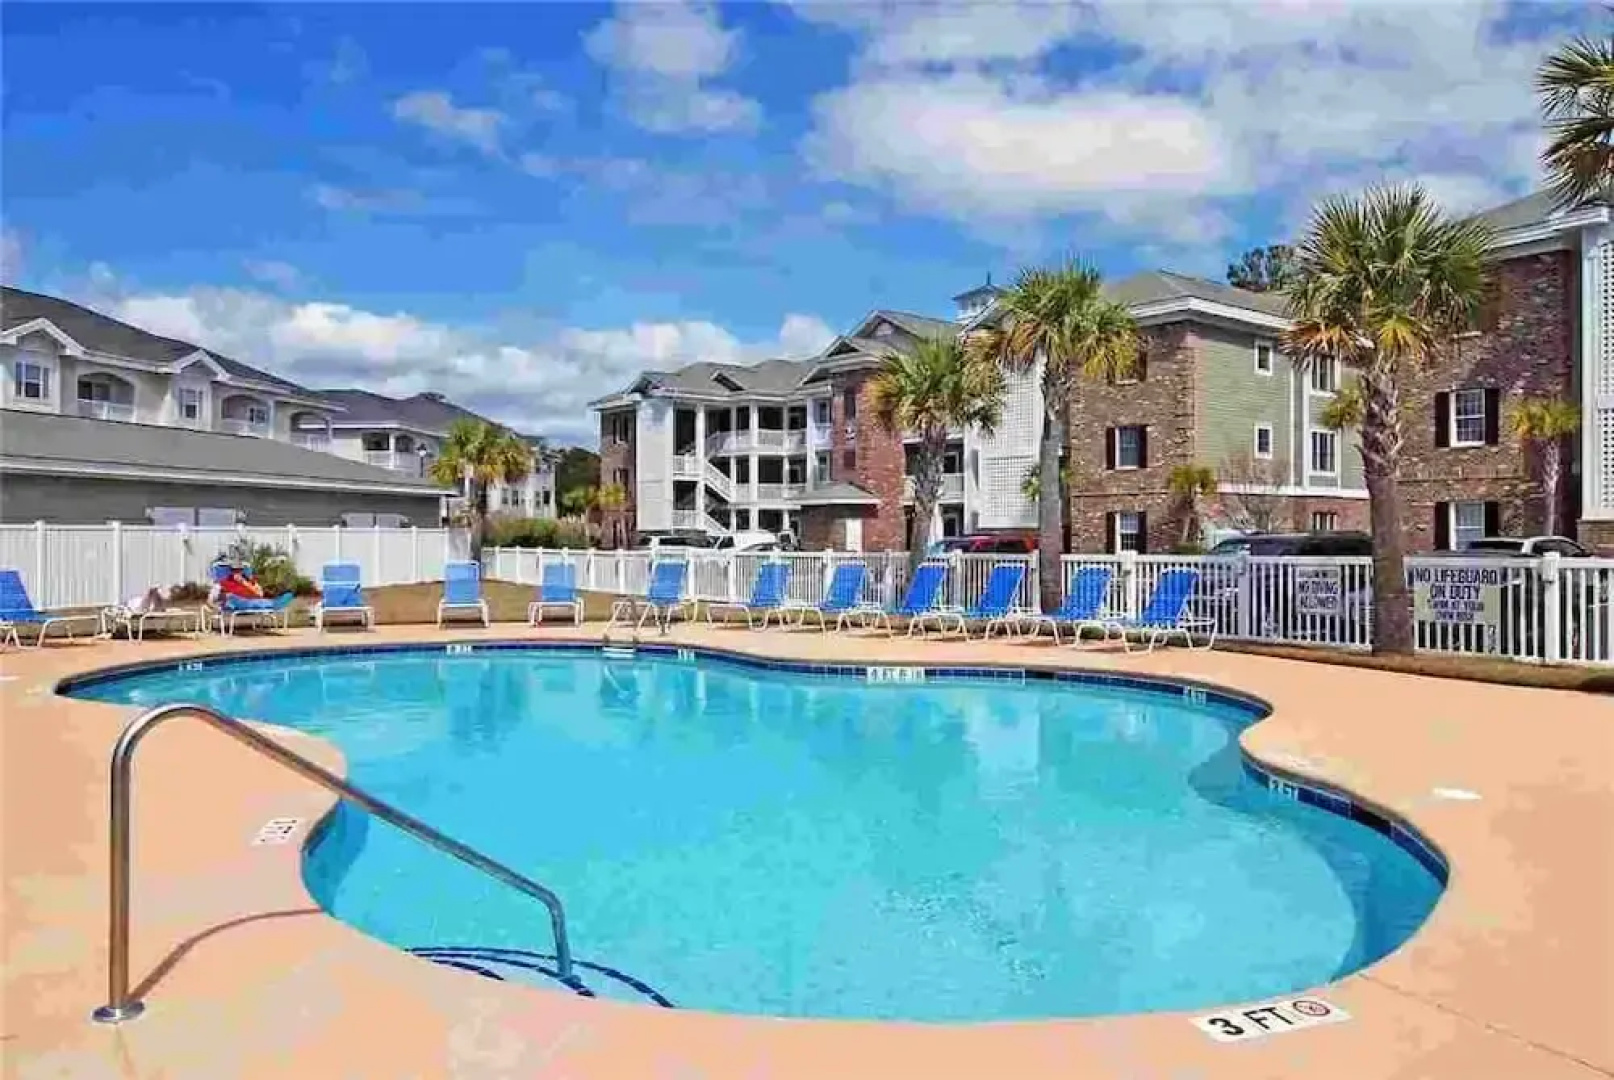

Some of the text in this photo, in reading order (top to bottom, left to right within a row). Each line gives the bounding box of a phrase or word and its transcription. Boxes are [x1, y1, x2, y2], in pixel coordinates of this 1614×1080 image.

[1415, 567, 1497, 585] NO LIFEGUARD
[1430, 584, 1480, 599] ON DUTY
[1208, 1006, 1294, 1036] 3 FT
